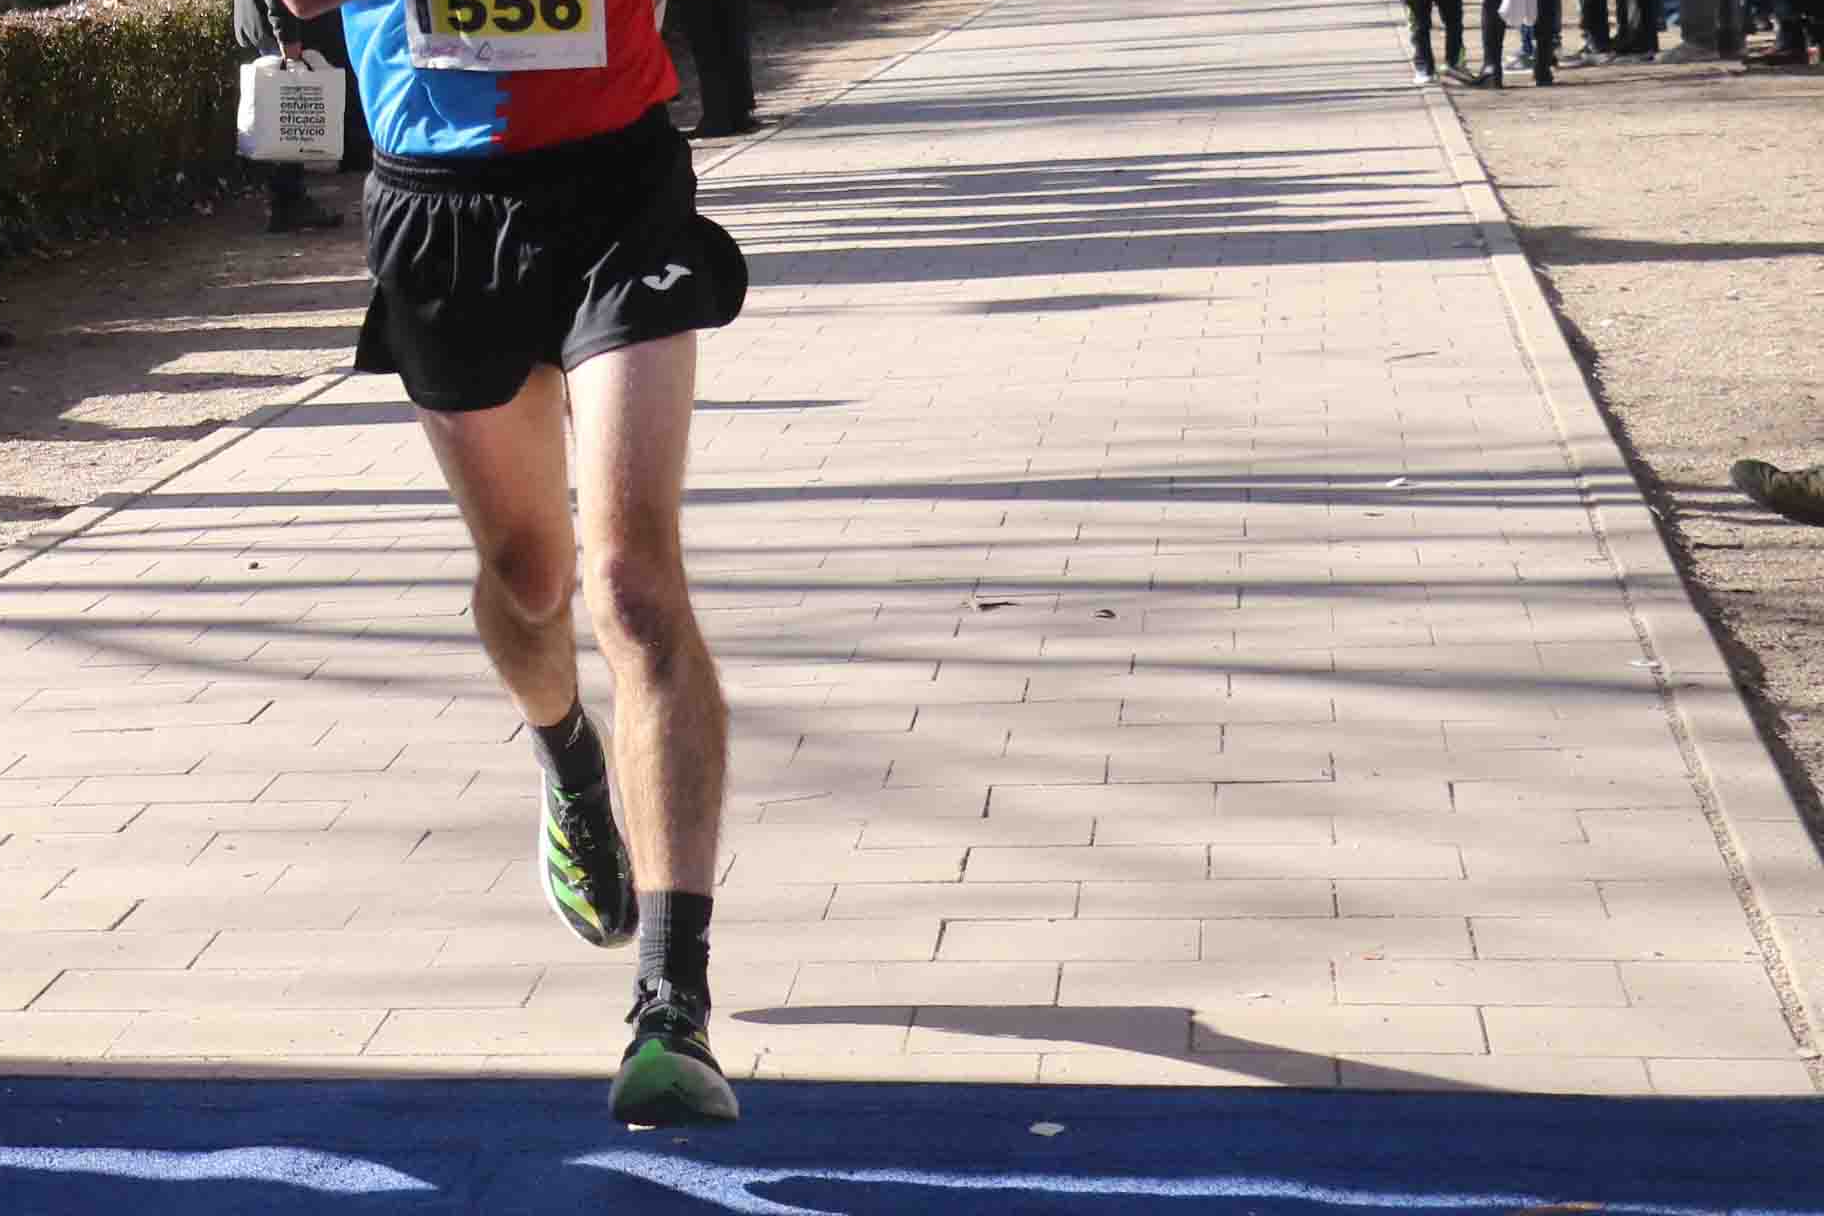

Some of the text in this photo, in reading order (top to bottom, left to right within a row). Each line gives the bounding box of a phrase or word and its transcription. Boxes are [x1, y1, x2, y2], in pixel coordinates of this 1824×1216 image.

[279, 101, 325, 111] esfuerzo
[279, 113, 326, 125] eficacia
[279, 127, 326, 137] servicio
